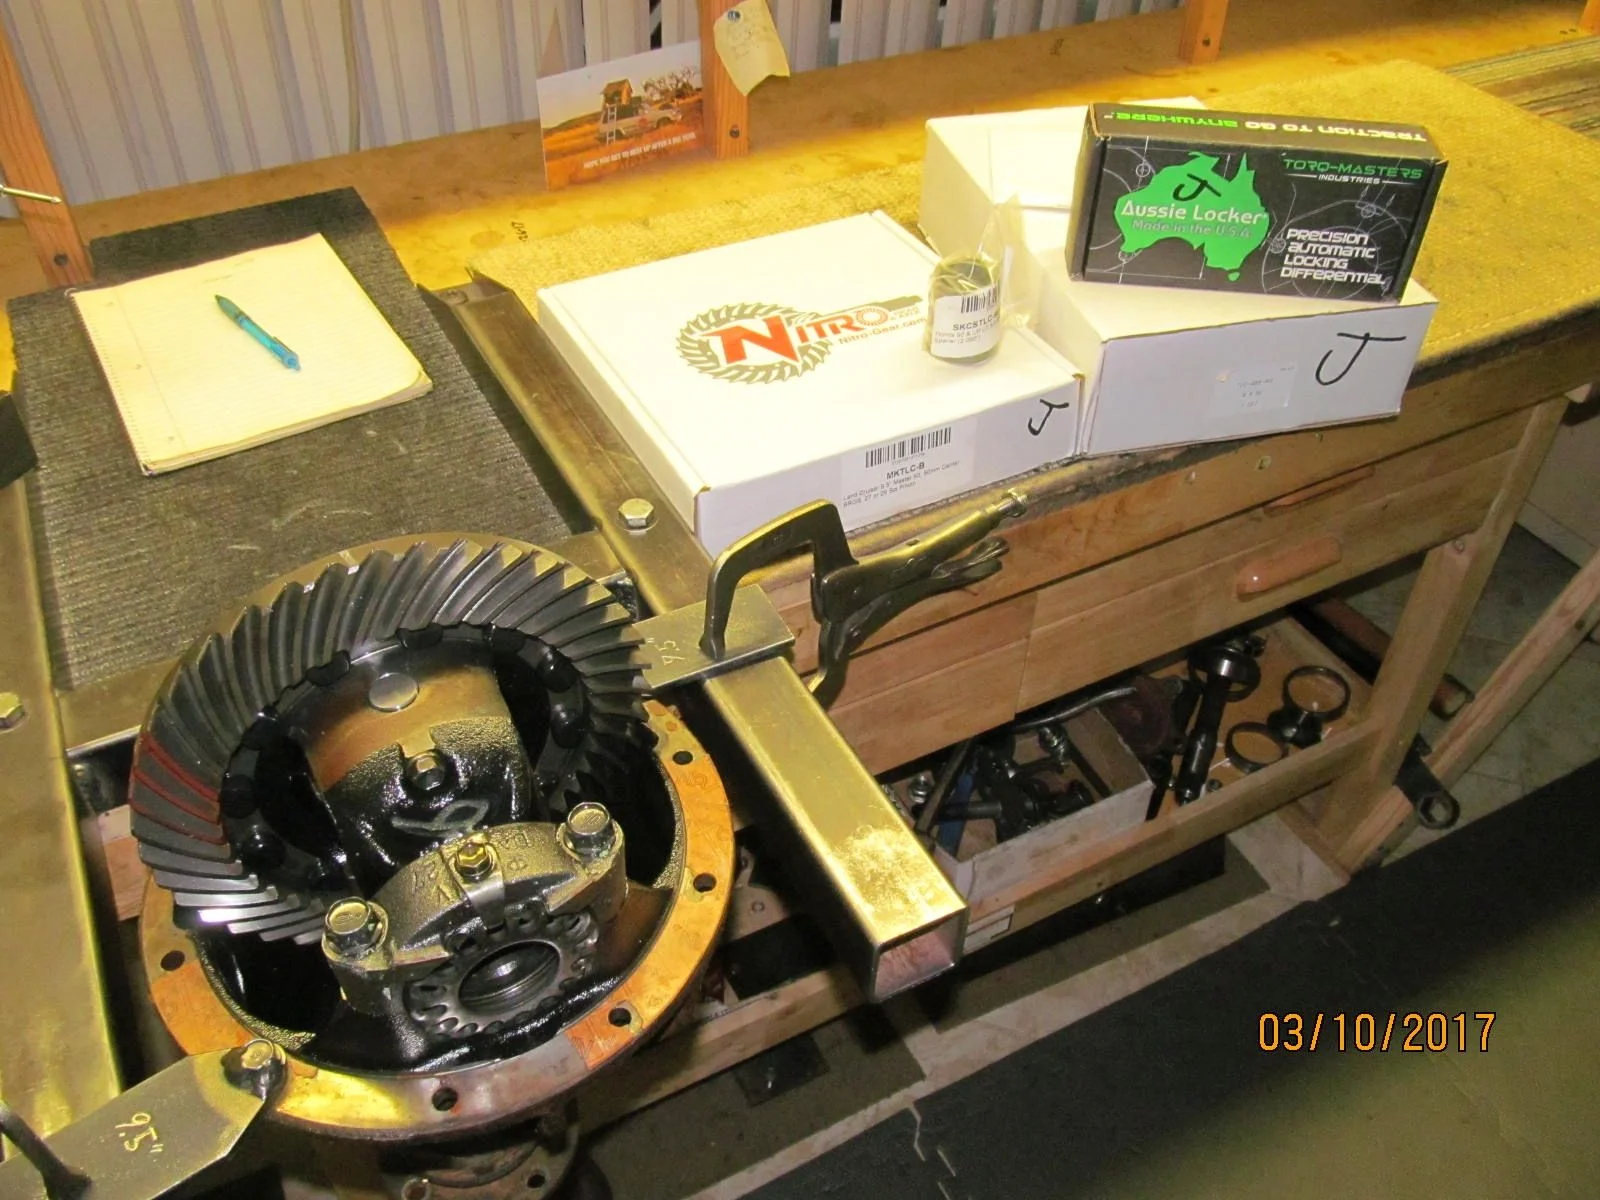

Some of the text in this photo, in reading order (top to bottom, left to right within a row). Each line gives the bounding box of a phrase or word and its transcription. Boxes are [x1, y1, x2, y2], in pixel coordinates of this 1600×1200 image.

[1244, 120, 1277, 131] GO
[1282, 122, 1313, 133] TO
[1317, 125, 1427, 142] TRACTION
[1283, 158, 1423, 181] TORQ-MASTERS
[1318, 173, 1381, 185] INDUSTRIES
[1172, 172, 1222, 202] J
[1121, 200, 1187, 220] Aussie
[1132, 219, 1169, 231] Made
[1173, 222, 1185, 232] in
[1188, 223, 1212, 235] the
[1286, 228, 1370, 246] PRECISION
[1284, 254, 1350, 270] LOCKING
[1280, 266, 1387, 285] DIFFERENTIAL
[1315, 332, 1407, 386] J
[1027, 398, 1070, 437] J
[886, 461, 925, 480] MKTLC-B
[114, 1112, 164, 1153] 9.5"
